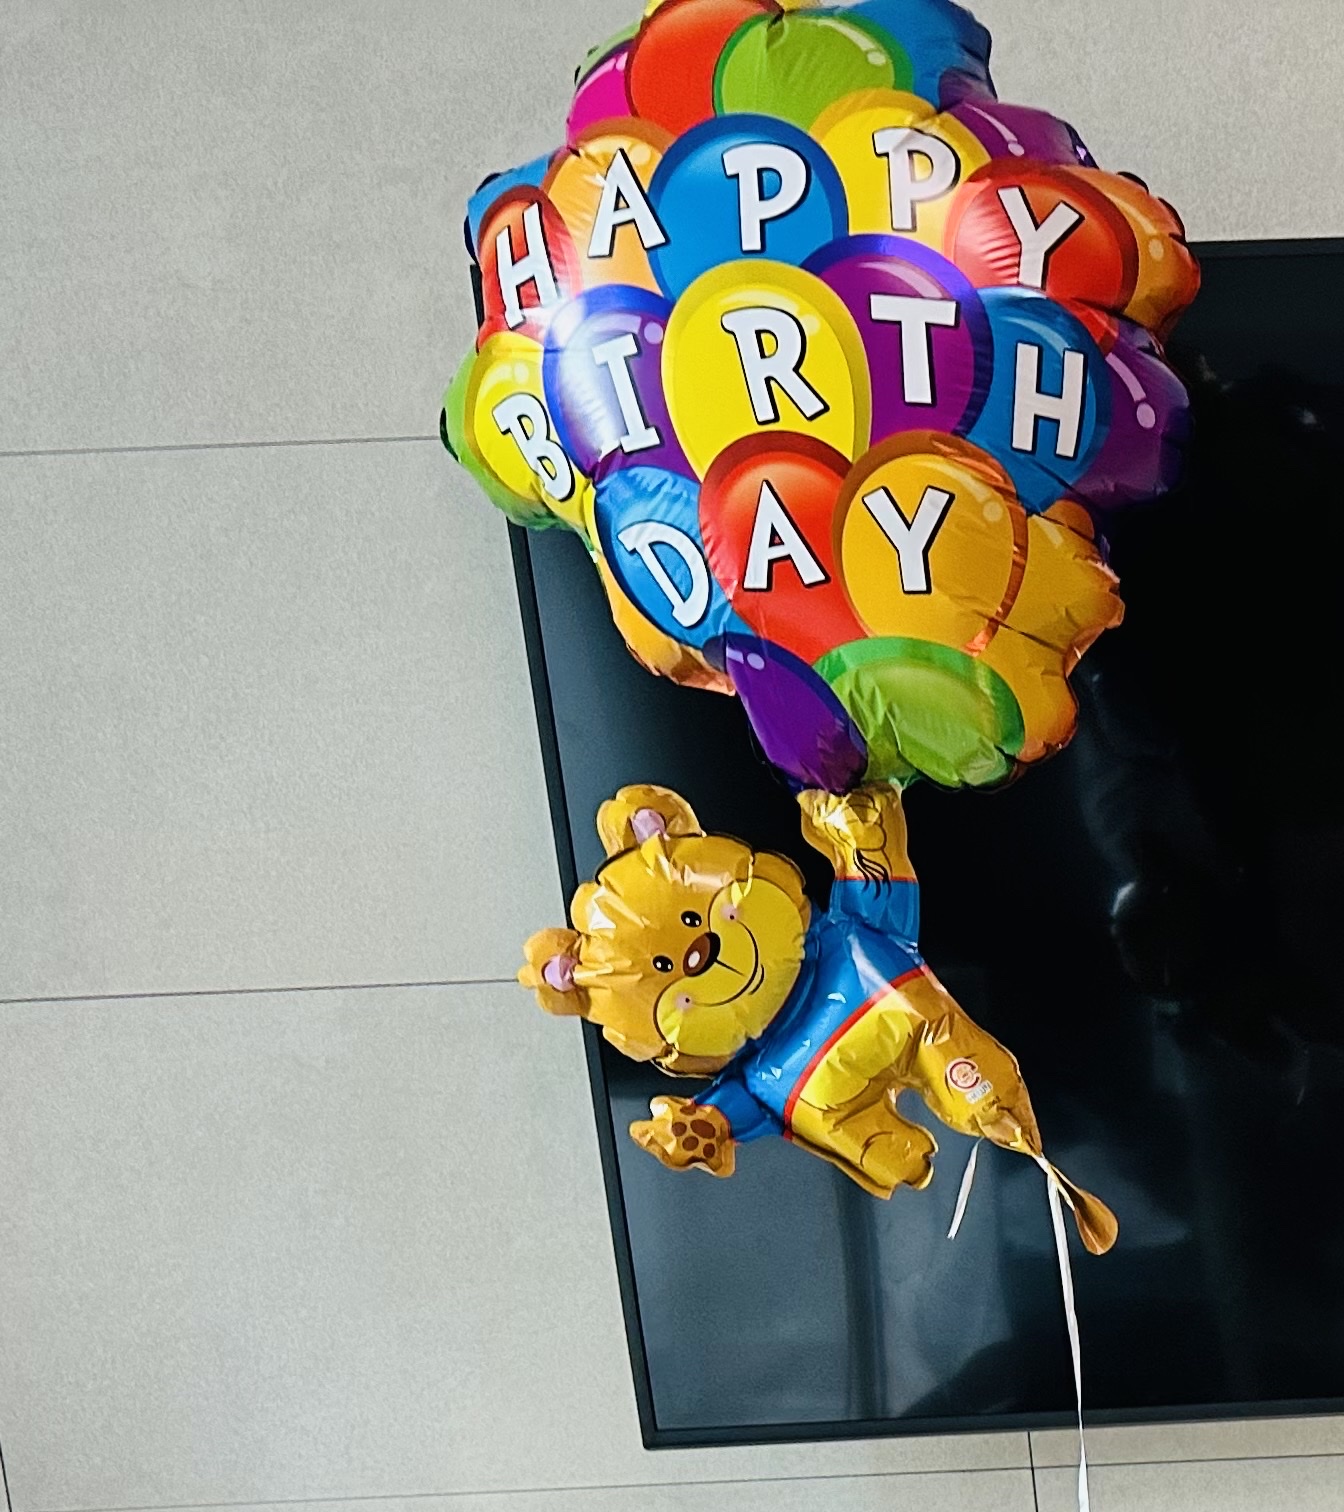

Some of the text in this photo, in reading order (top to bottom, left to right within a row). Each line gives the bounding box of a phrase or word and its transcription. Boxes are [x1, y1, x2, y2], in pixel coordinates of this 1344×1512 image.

[496, 126, 1083, 330] HAPPY
[493, 293, 1090, 503] BIRTH
[617, 479, 955, 629] DAY
